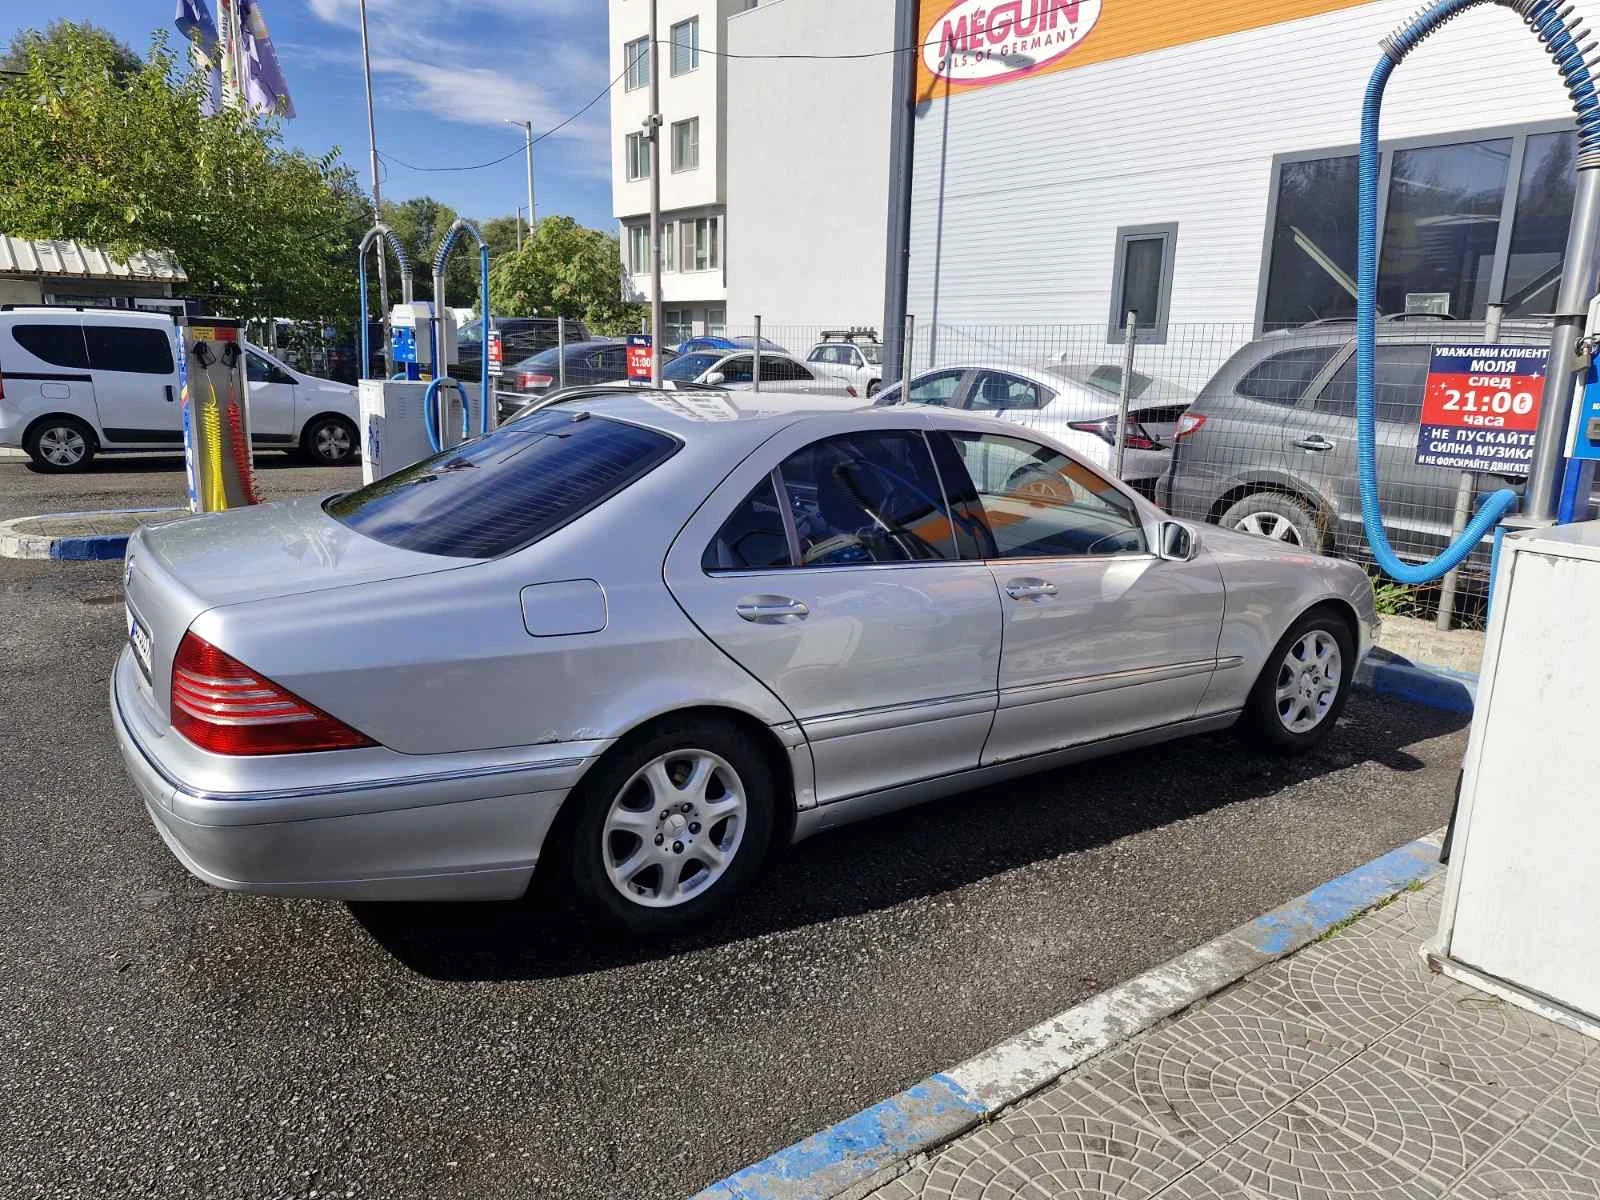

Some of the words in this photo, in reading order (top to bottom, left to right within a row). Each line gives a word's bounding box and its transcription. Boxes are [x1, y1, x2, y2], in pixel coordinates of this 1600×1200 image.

[975, 49, 992, 62] OF
[1000, 27, 1078, 57] GERMANY
[1435, 347, 1499, 358] УВАЖАЕМИ
[1470, 360, 1517, 373] МОЛЯ
[1468, 376, 1512, 389] след
[1442, 390, 1534, 415] 21:00
[1463, 414, 1505, 427] часа
[1431, 428, 1450, 440] НЕ
[1429, 441, 1473, 455] СИЛНА
[1475, 445, 1534, 460] МУЗИКА
[1418, 455, 1425, 463] И
[1425, 455, 1436, 465] НЕ
